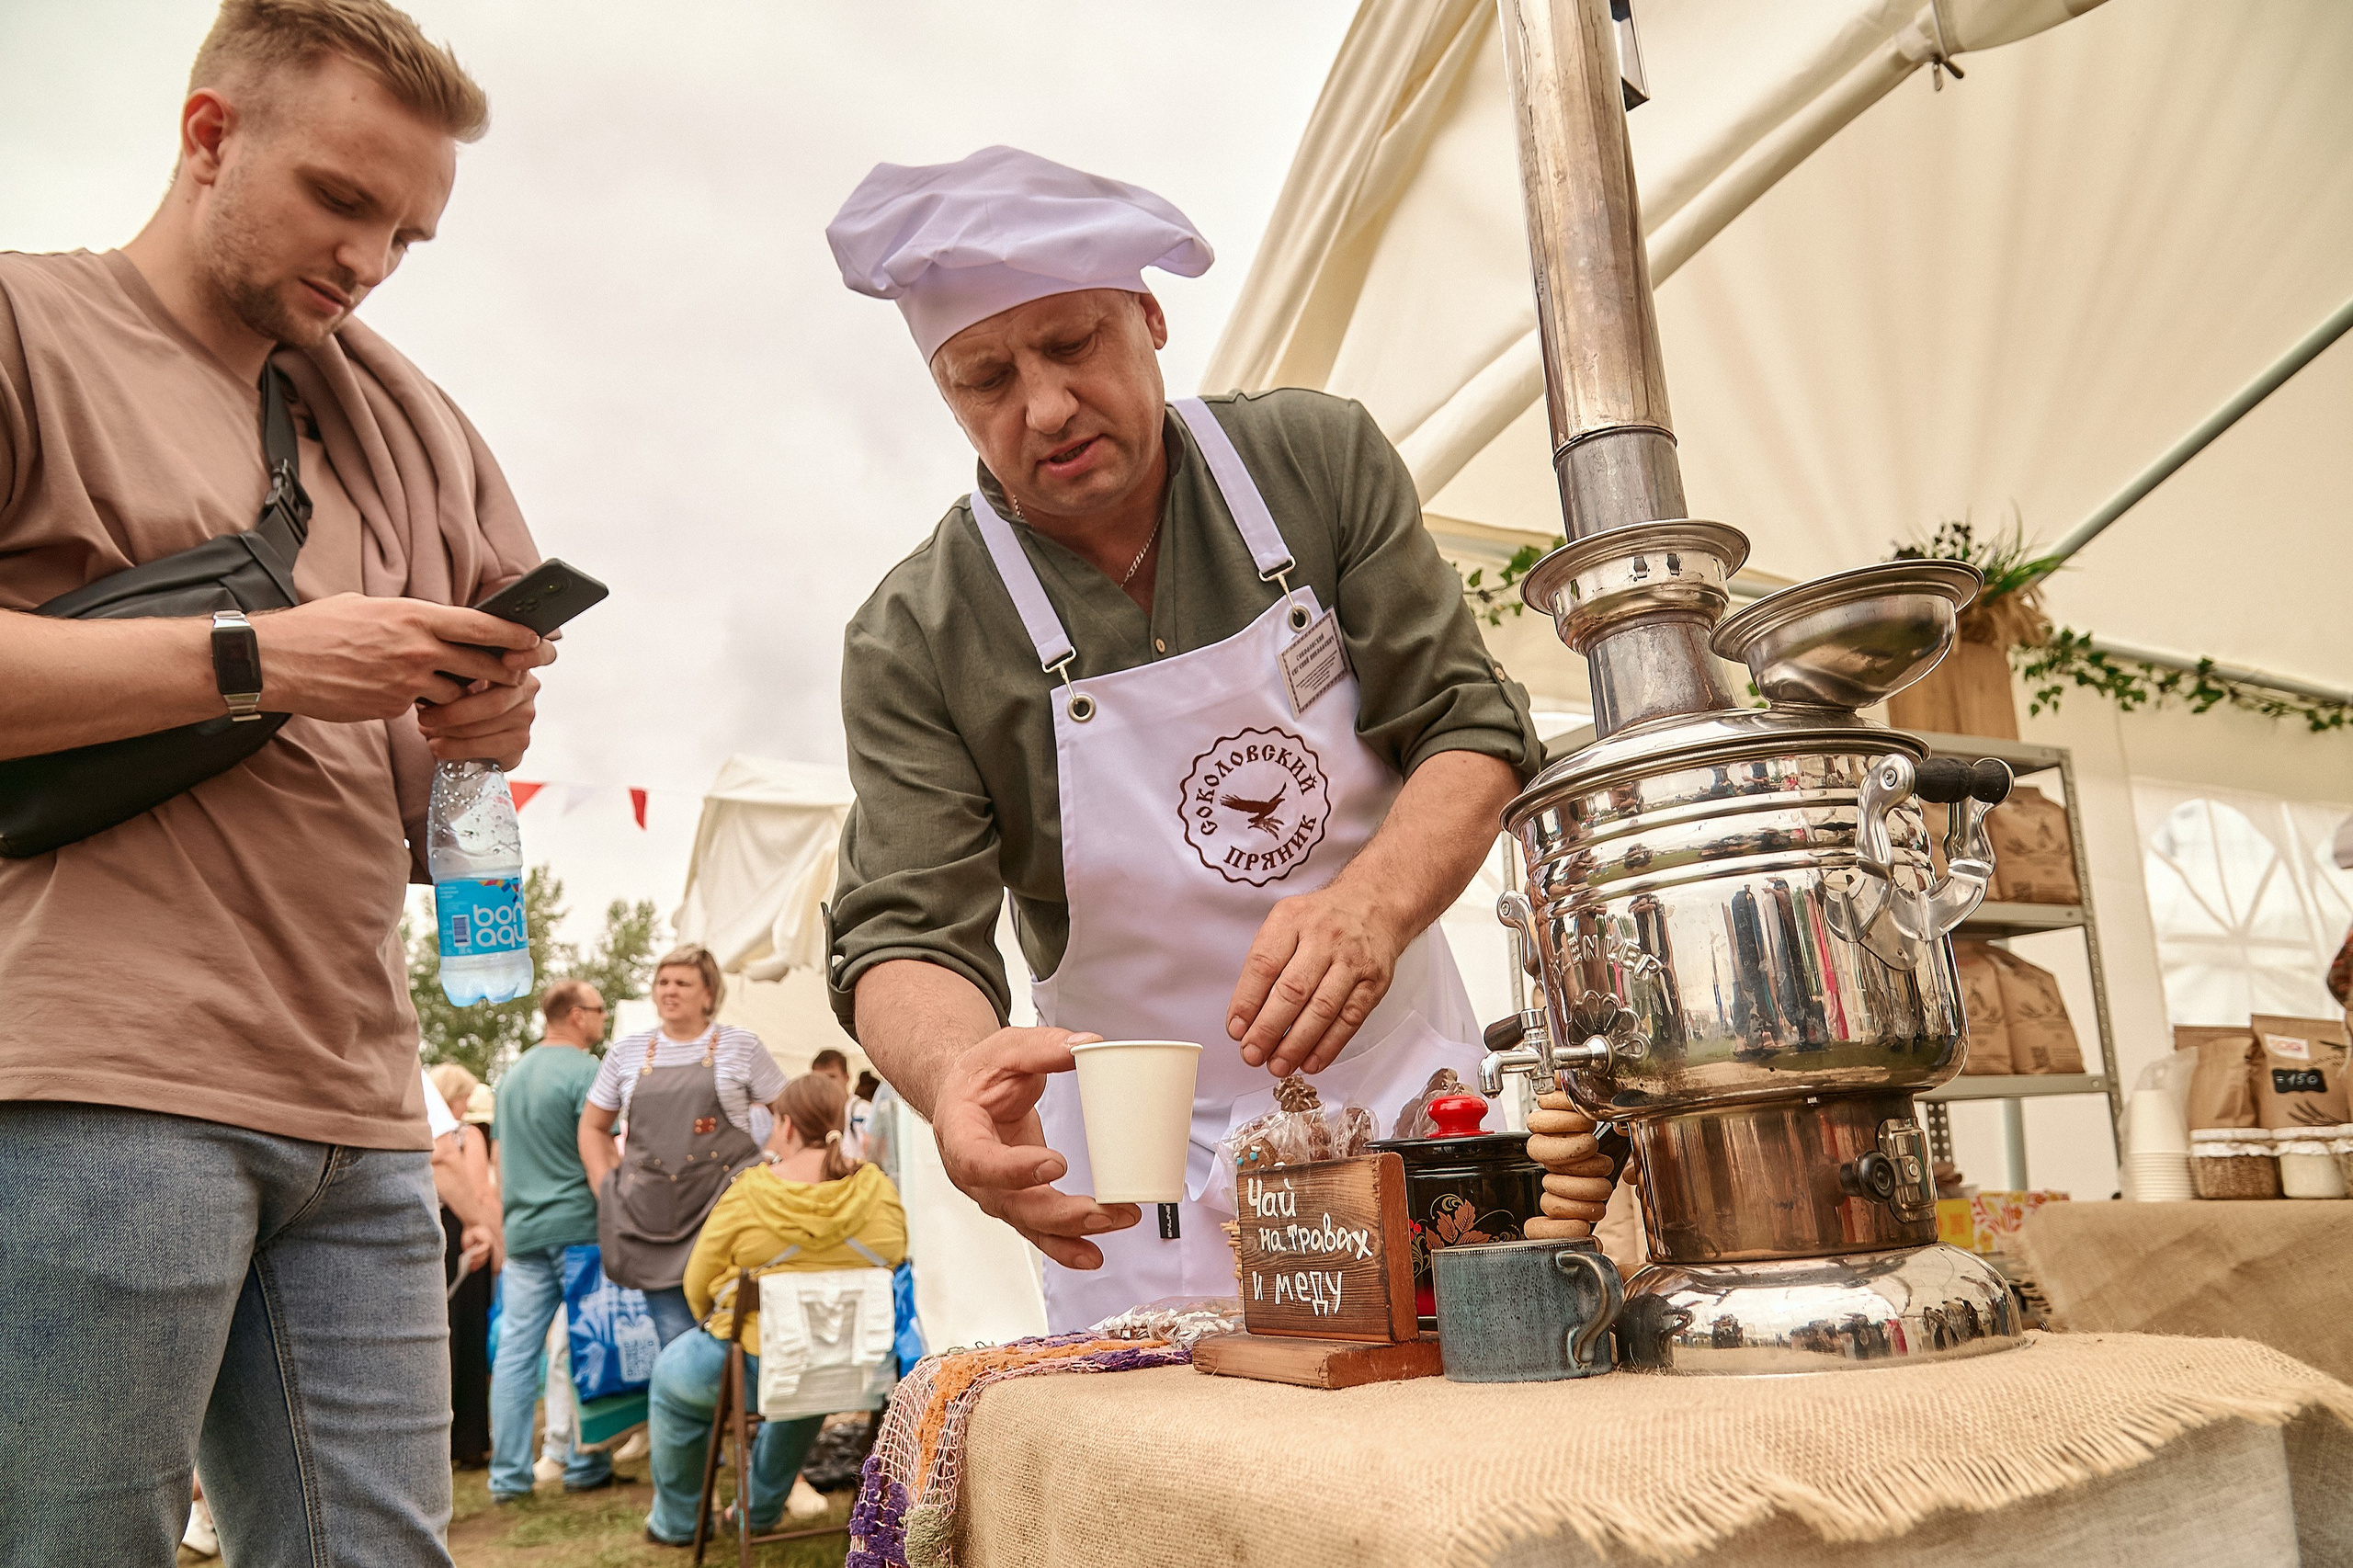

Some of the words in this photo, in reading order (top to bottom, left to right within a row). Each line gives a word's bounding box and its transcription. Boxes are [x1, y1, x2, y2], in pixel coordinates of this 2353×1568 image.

[1196, 744, 1318, 835] СОКОЛОВСКИЙ
[1223, 814, 1317, 871] ПРЯНИК
[472, 901, 525, 927] bon
[1247, 1177, 1297, 1218] Чай
[1258, 1226, 1286, 1254] на
[1287, 1212, 1373, 1260] травах
[1275, 1270, 1343, 1317] меду
